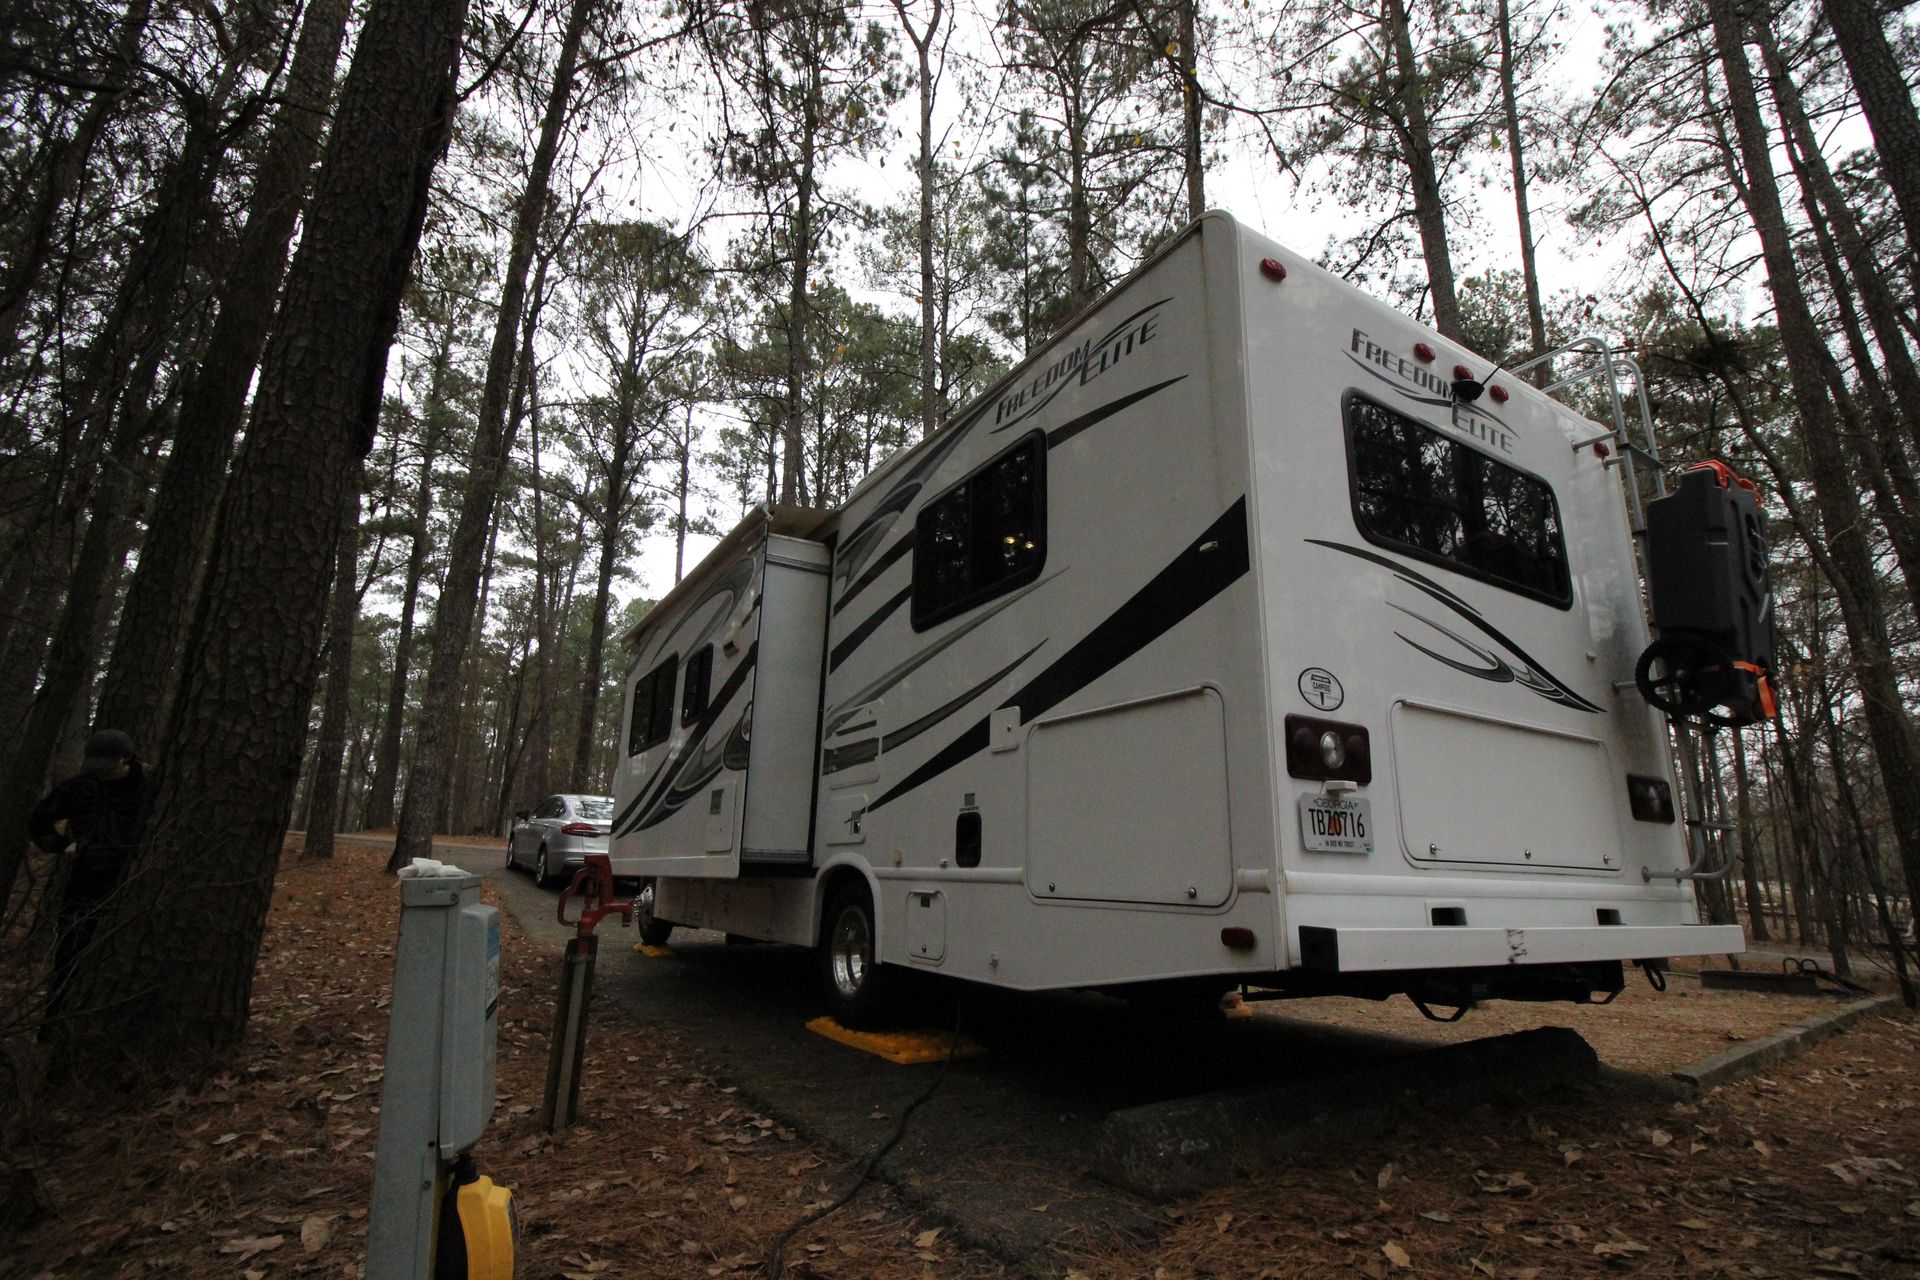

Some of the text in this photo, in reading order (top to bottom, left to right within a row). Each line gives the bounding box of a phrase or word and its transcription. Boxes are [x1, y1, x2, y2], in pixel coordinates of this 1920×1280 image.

[996, 338, 1091, 424] FREEDOM
[1080, 313, 1159, 387] ELITE
[1352, 328, 1457, 403] FREEDOM
[1452, 404, 1513, 454] ELITE
[1308, 808, 1365, 838] TBZ0716
[1316, 798, 1354, 809] GEORGIA
